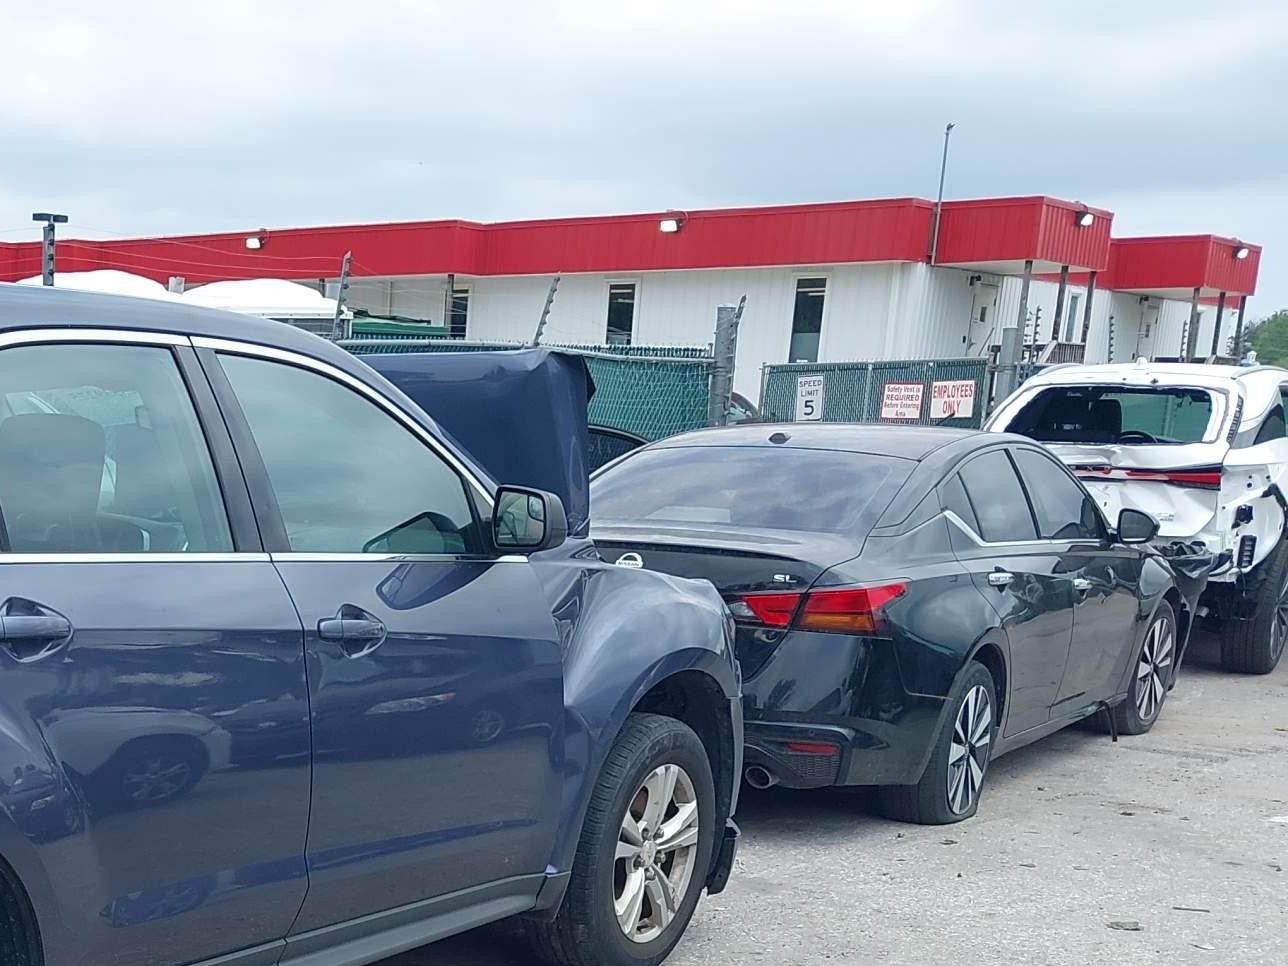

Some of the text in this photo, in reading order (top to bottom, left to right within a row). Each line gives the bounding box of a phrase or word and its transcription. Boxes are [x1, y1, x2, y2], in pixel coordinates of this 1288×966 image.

[887, 386, 903, 394] Safety
[933, 384, 973, 399] EMPLOYEES
[803, 400, 815, 416] 5
[942, 400, 961, 414] ONLY
[773, 574, 798, 583] SL
